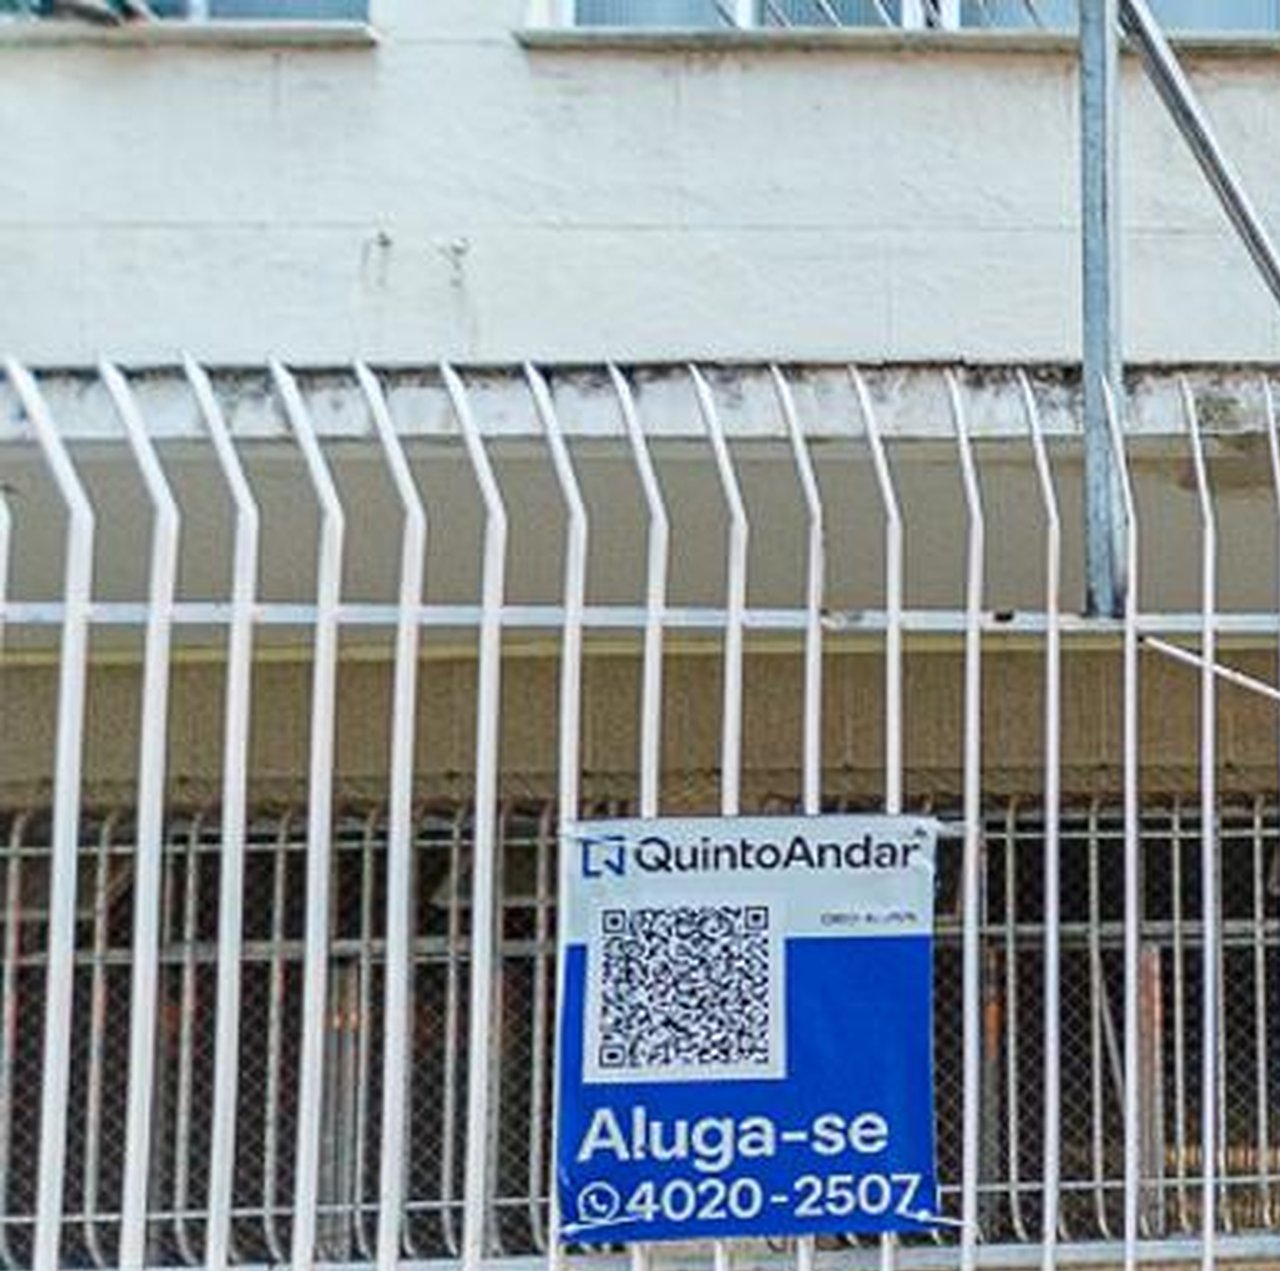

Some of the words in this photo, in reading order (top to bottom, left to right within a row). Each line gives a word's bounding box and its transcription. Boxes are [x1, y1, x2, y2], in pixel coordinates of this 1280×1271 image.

[634, 832, 919, 873] QuintoAndar
[576, 1104, 889, 1174] Aluga-se
[625, 1172, 922, 1222] 4020-2507
